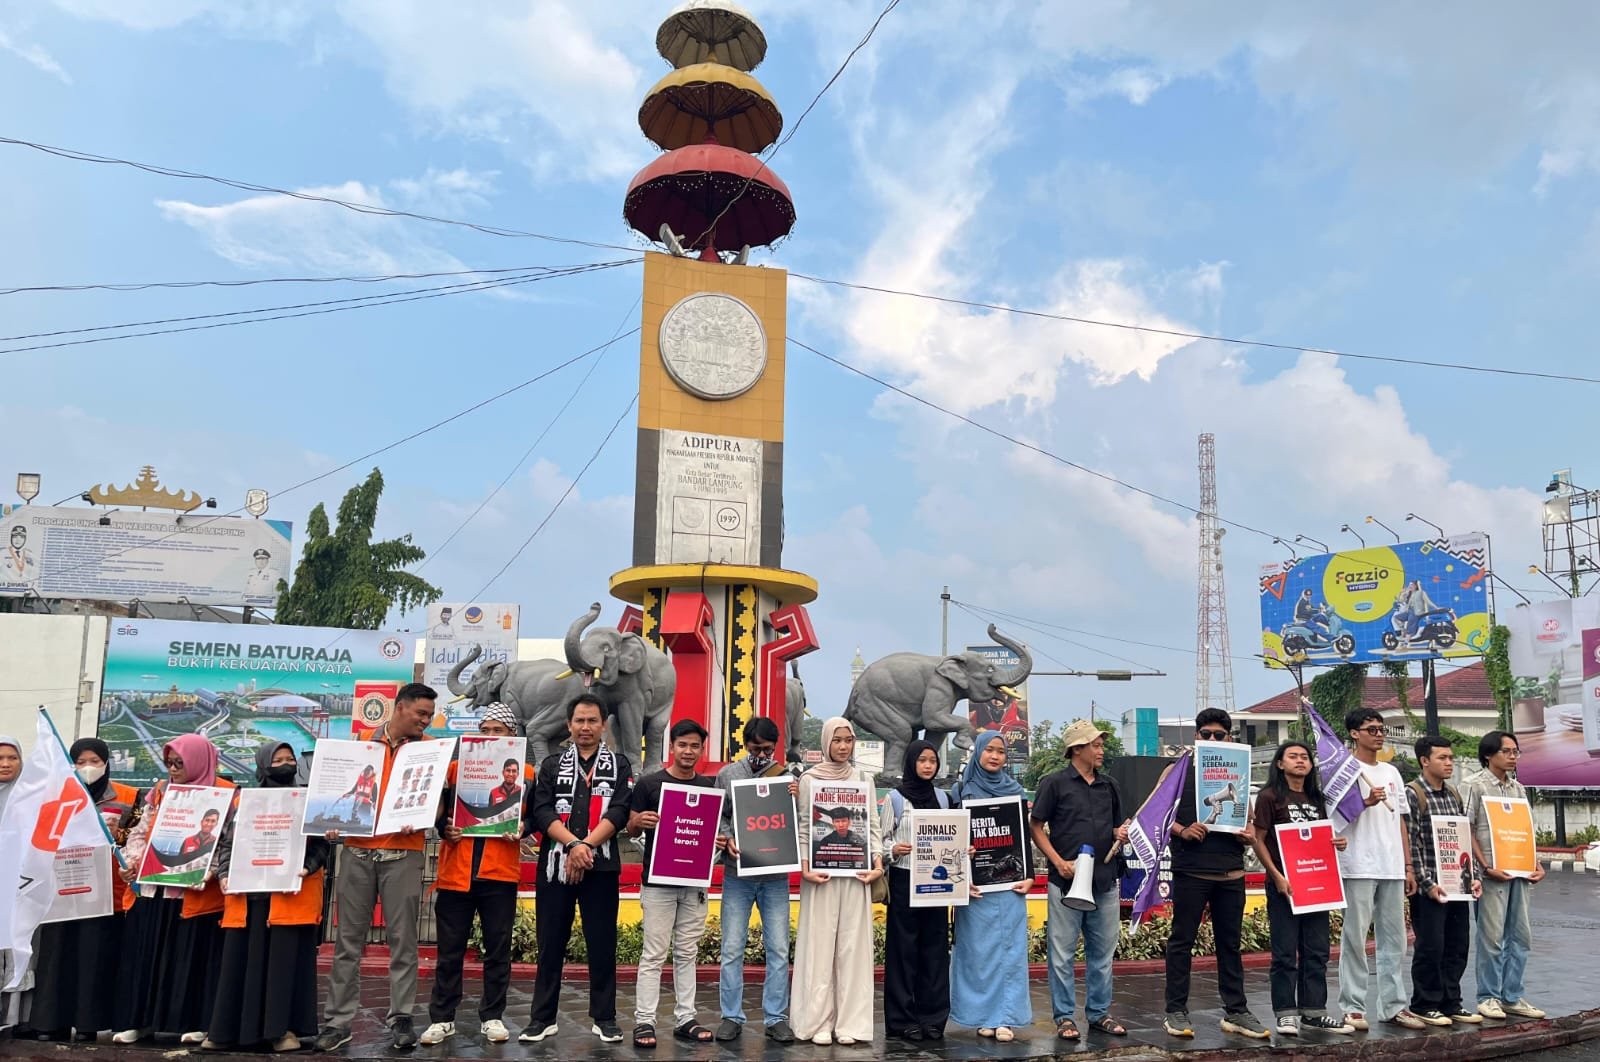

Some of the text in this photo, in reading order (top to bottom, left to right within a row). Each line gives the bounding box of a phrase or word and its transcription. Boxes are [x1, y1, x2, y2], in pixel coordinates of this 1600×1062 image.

[682, 436, 741, 452] ADIPURA
[704, 462, 719, 470] UNTUK
[678, 475, 743, 490] BANDAR LAMPUNG
[720, 515, 737, 523] 1997
[32, 517, 75, 527] PROGRAM
[125, 522, 167, 532] WALIKOTA
[205, 527, 245, 537] LAMPUNG
[1336, 567, 1389, 584] Fazzio
[1349, 582, 1376, 590] HYBRID
[117, 625, 138, 636] SIG
[168, 641, 352, 663] SEMEN BATURAJA
[431, 648, 460, 664] Idul
[168, 657, 352, 674] BUKTI KEKUATAN NYATA
[1202, 754, 1223, 762] SUARA
[1202, 760, 1238, 768] KEBENARAN
[1203, 767, 1228, 775] JANGAN
[815, 792, 867, 804] ANDRE NUGROHO
[675, 816, 704, 827] Jurnalis
[746, 813, 787, 831] SOS!
[971, 817, 996, 828] BERITA
[676, 826, 700, 836] bukan
[917, 825, 957, 836] JURNALIS
[973, 825, 1010, 838] TAK BOLEH
[674, 837, 699, 846] teroris
